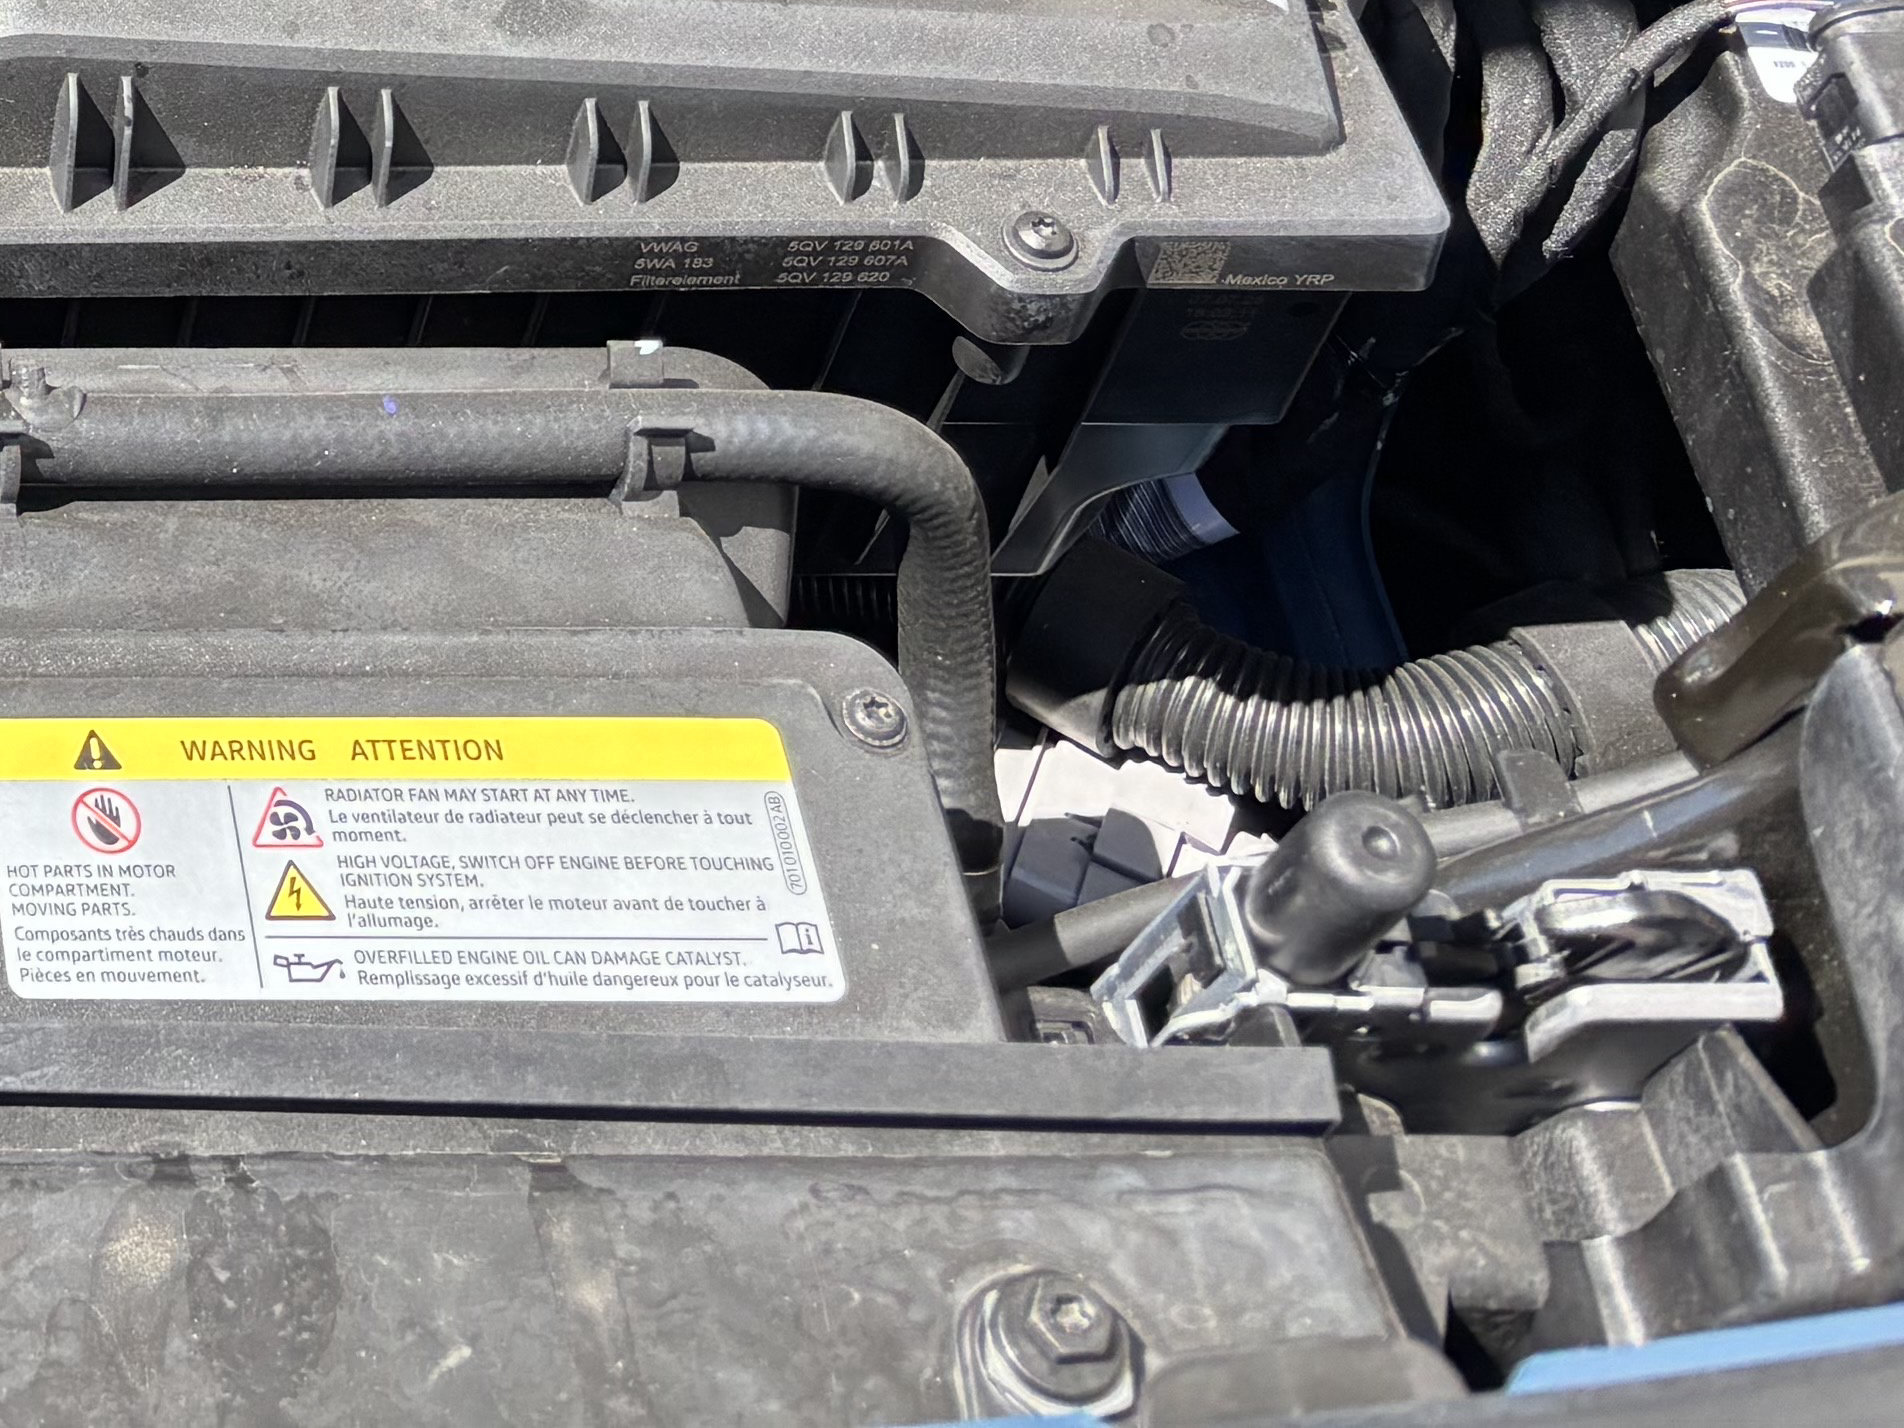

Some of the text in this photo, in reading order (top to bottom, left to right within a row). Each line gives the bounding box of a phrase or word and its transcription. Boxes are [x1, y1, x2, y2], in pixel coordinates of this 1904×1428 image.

[640, 240, 699, 253] VWAG
[629, 270, 741, 287] Filterelement
[1224, 273, 1335, 285] Mexico YRP
[180, 738, 504, 761] WARNING ATTENTION
[324, 787, 635, 803] RADIATOR FAN MAY START AT ANY TIME.
[328, 808, 753, 827] Le ventilateur de radiateur peut se déclencher à tout
[332, 829, 407, 842] moment.
[6, 863, 176, 879] HOT PARTS IN MOTOR
[337, 854, 775, 872] HIGH VOLTAGE, SWITCH OFF ENGINE BEFORE TOUCHING
[340, 872, 485, 888] IGNITION SYSTEM.
[8, 882, 135, 897] COMPARTMENT.
[11, 901, 136, 917] MOVING PARTS.
[344, 893, 767, 913] Haute tension, arrêter le moteur avant de toucher à
[347, 913, 439, 931] l'allumage.
[14, 925, 246, 944] Composants très chauds dans
[17, 947, 223, 965] le compartiment moteur.
[353, 949, 747, 966] OVERFILLED ENGINE OIL CAN DAMAGE CATALYST.
[19, 967, 206, 983] Pièces en mouvement.
[357, 969, 833, 992] Remplissage excessif d'huile dangereux pour le catalyseur.
